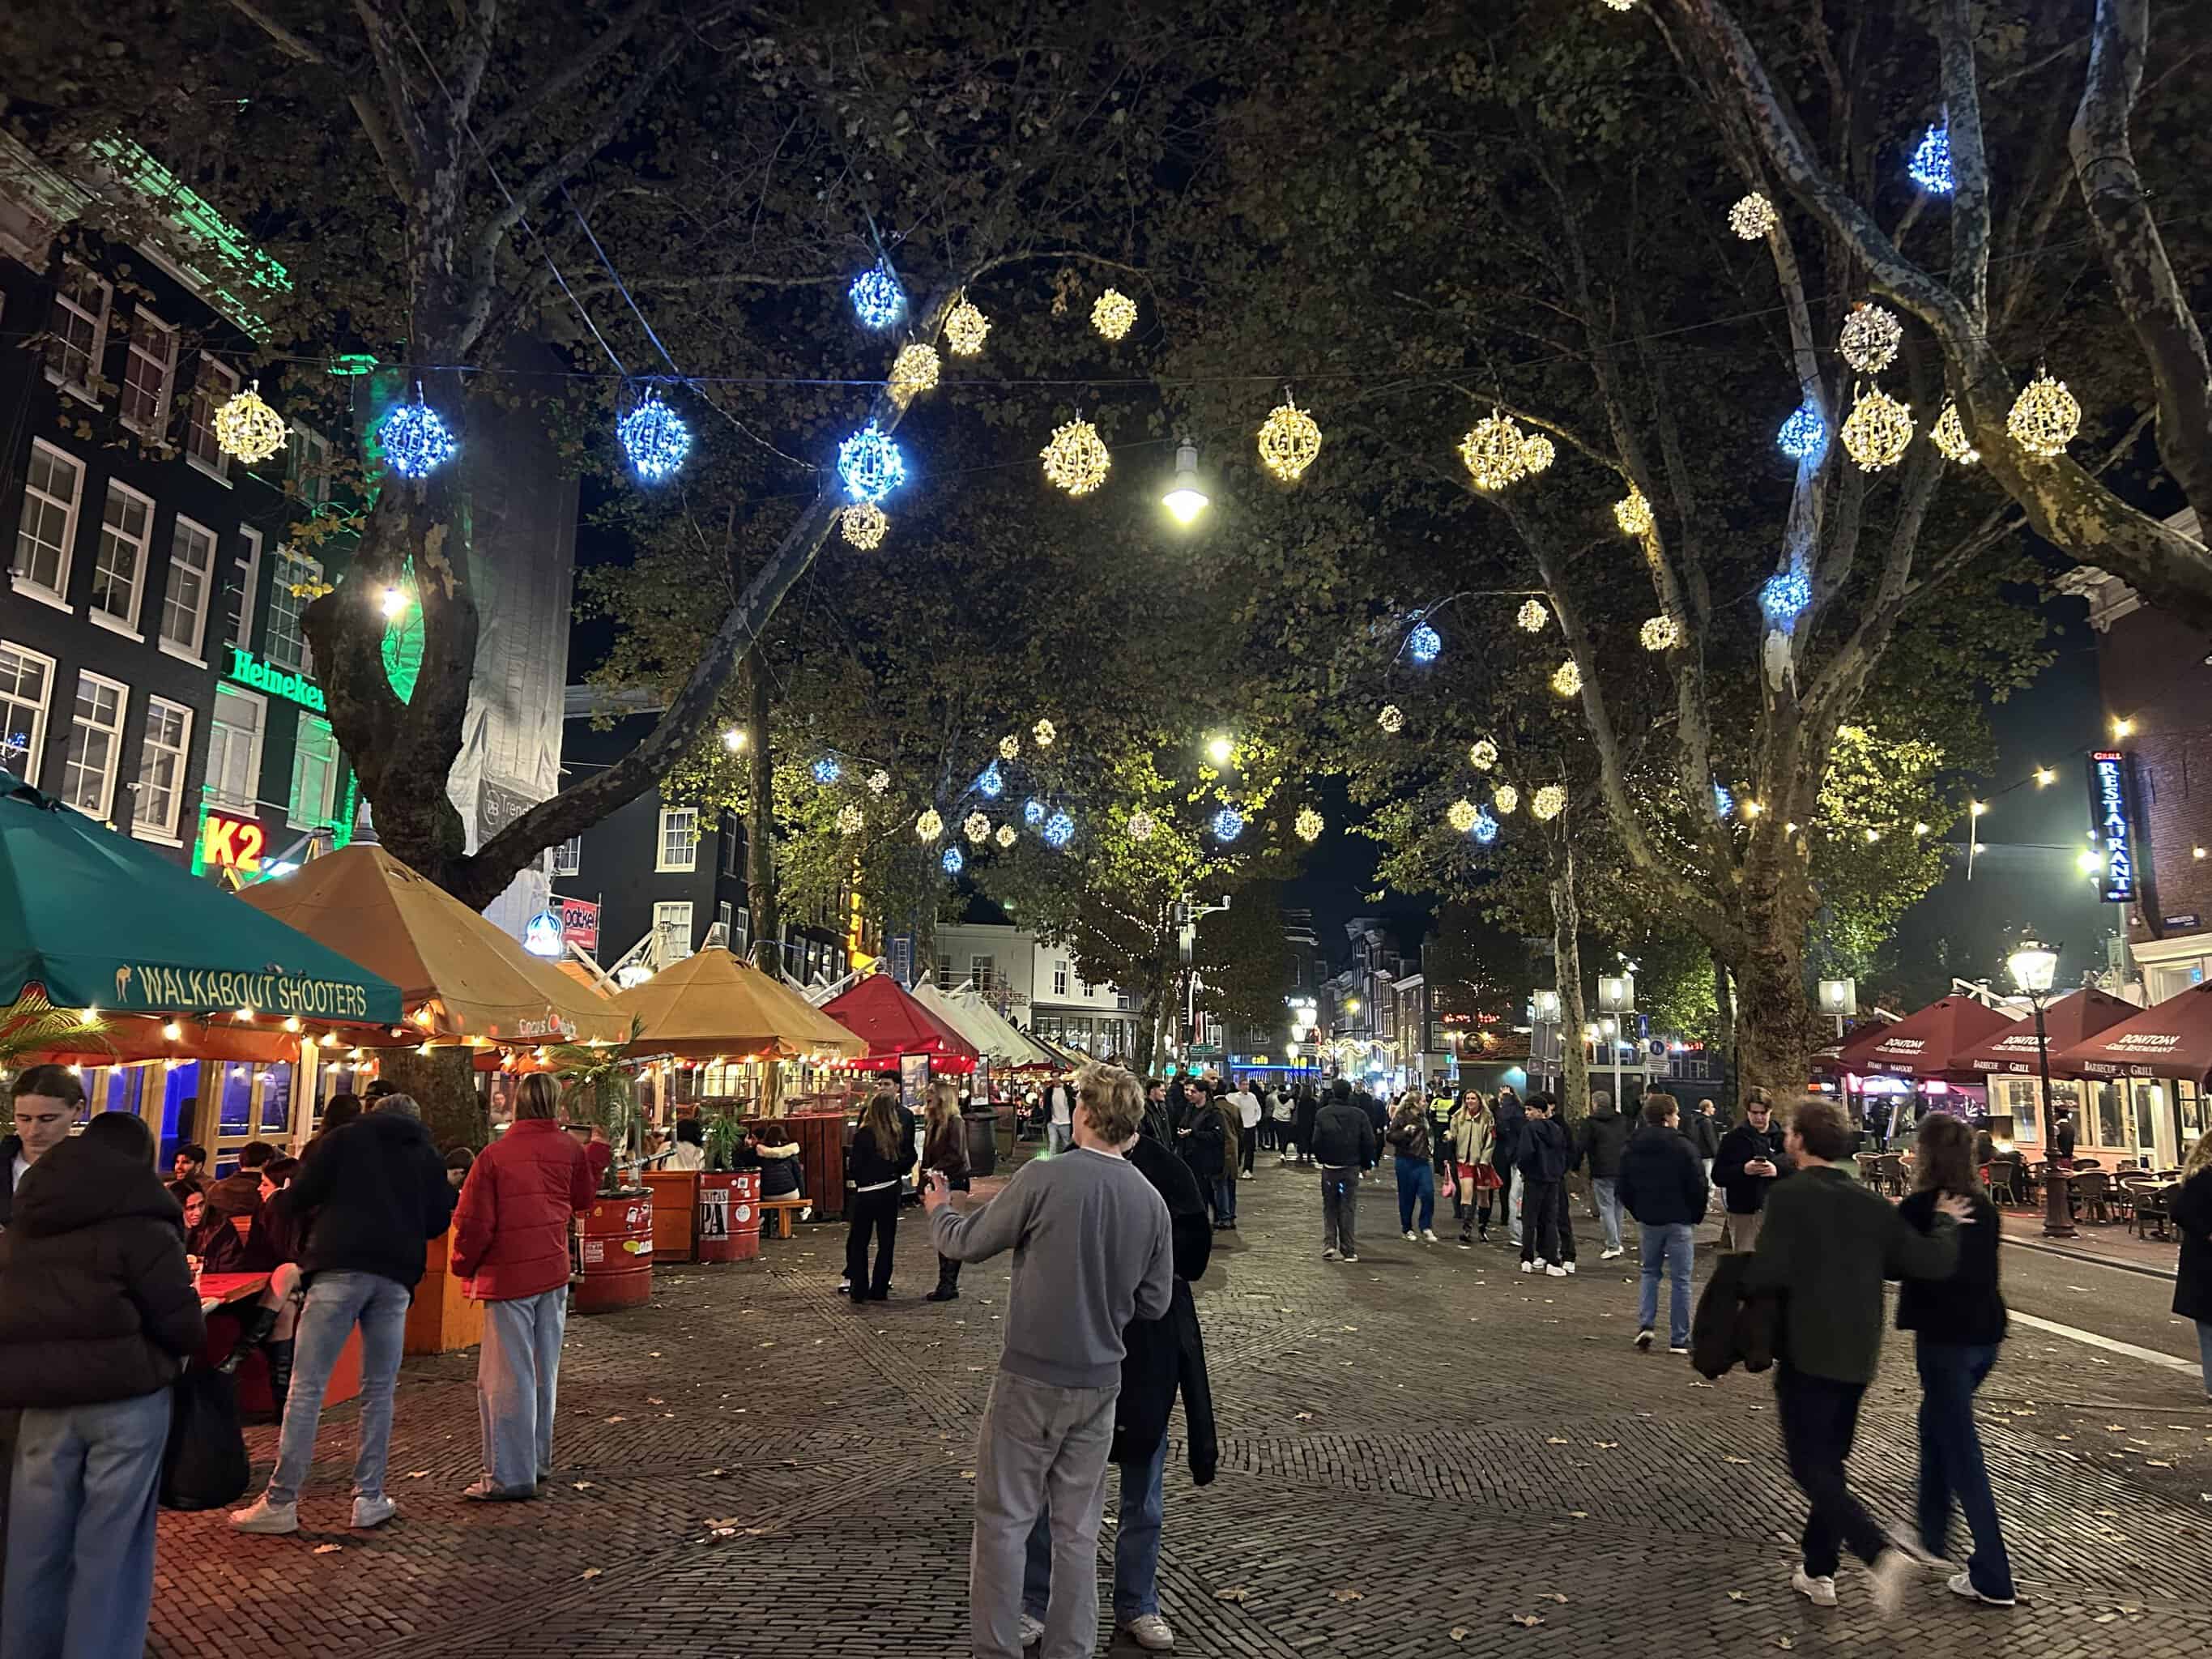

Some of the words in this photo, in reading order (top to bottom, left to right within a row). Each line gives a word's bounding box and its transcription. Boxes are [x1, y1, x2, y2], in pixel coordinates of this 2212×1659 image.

[202, 816, 262, 871] K2
[2097, 762, 2131, 890] RESTAURANT
[137, 965, 274, 1009] WALKABOUT
[278, 976, 367, 1016] SHOOTERS
[2010, 1062, 2030, 1073] GRILL
[2084, 1061, 2116, 1073] BARBECUE
[2130, 1064, 2153, 1076] GRILL
